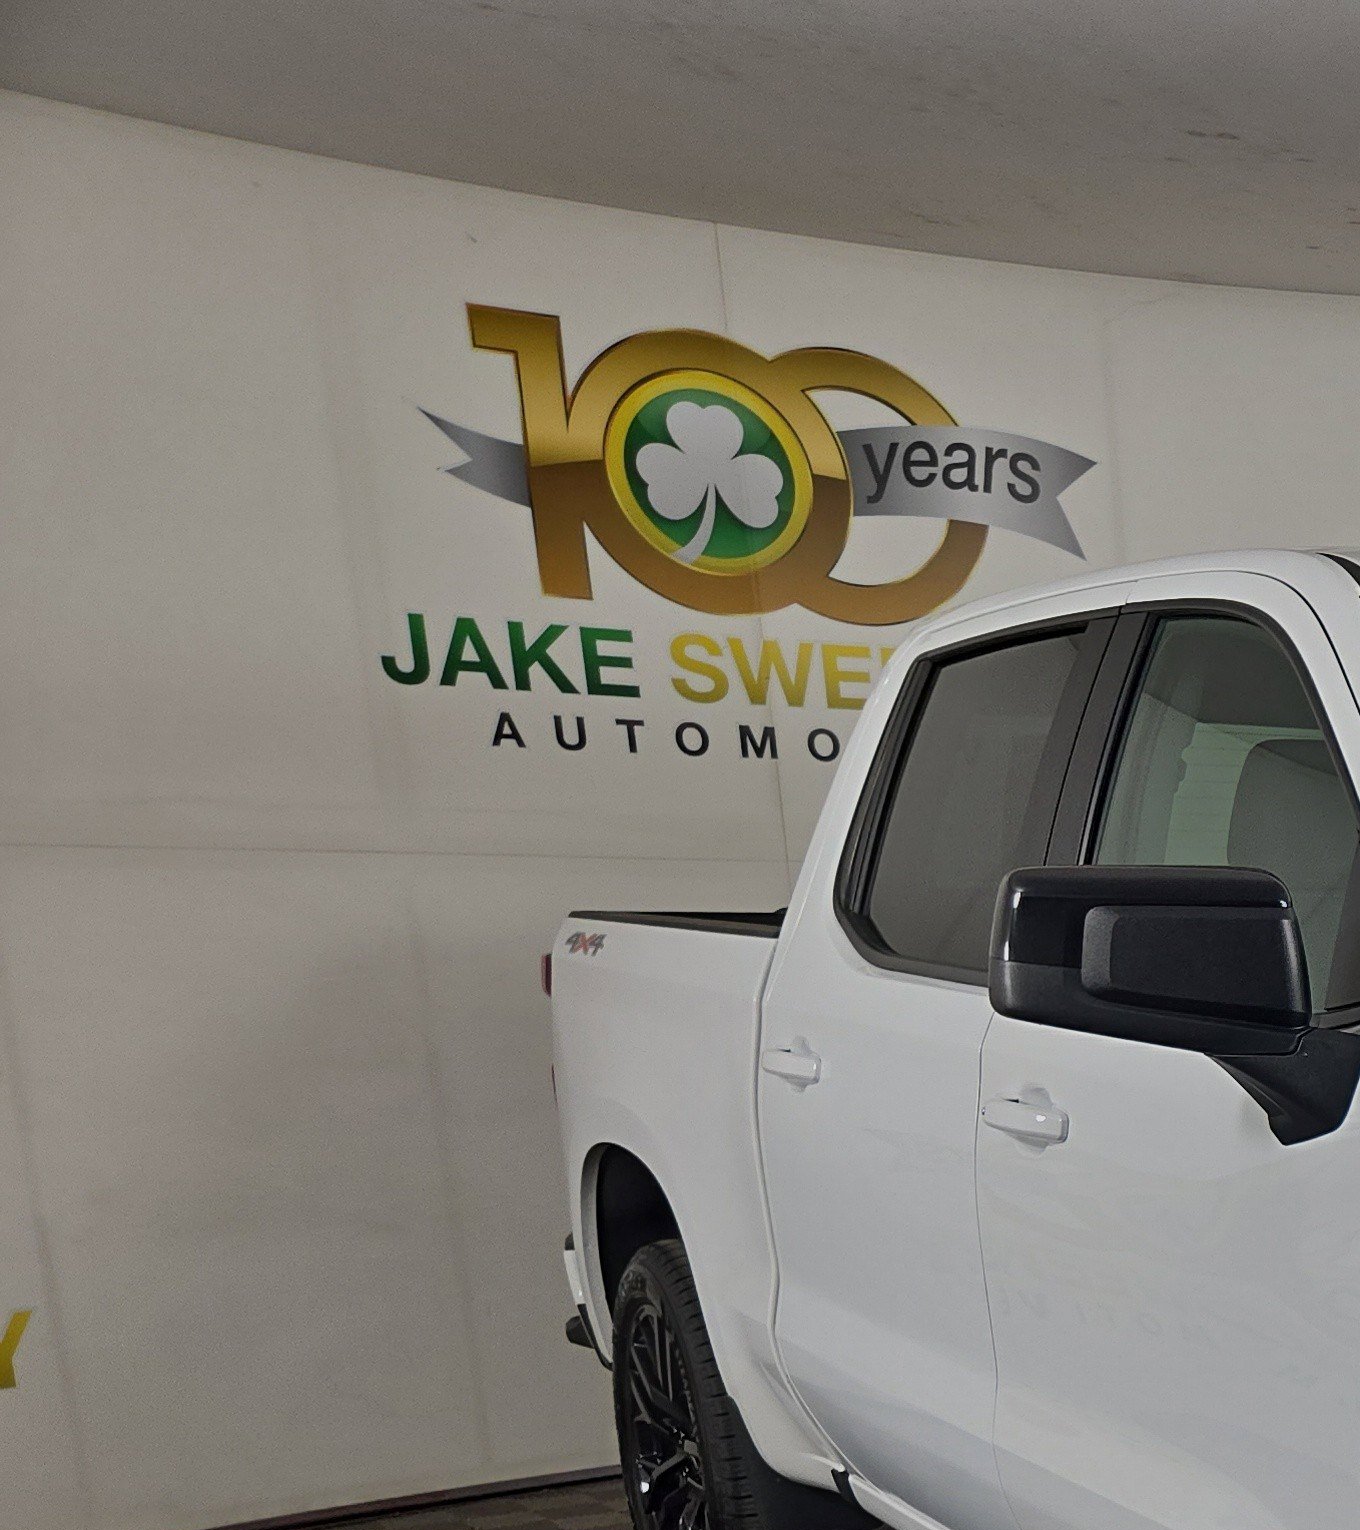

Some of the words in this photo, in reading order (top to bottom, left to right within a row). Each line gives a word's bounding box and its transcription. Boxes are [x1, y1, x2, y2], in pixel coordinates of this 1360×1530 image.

[862, 438, 1042, 504] years
[381, 612, 641, 698] JAKE
[669, 633, 897, 711] SWE
